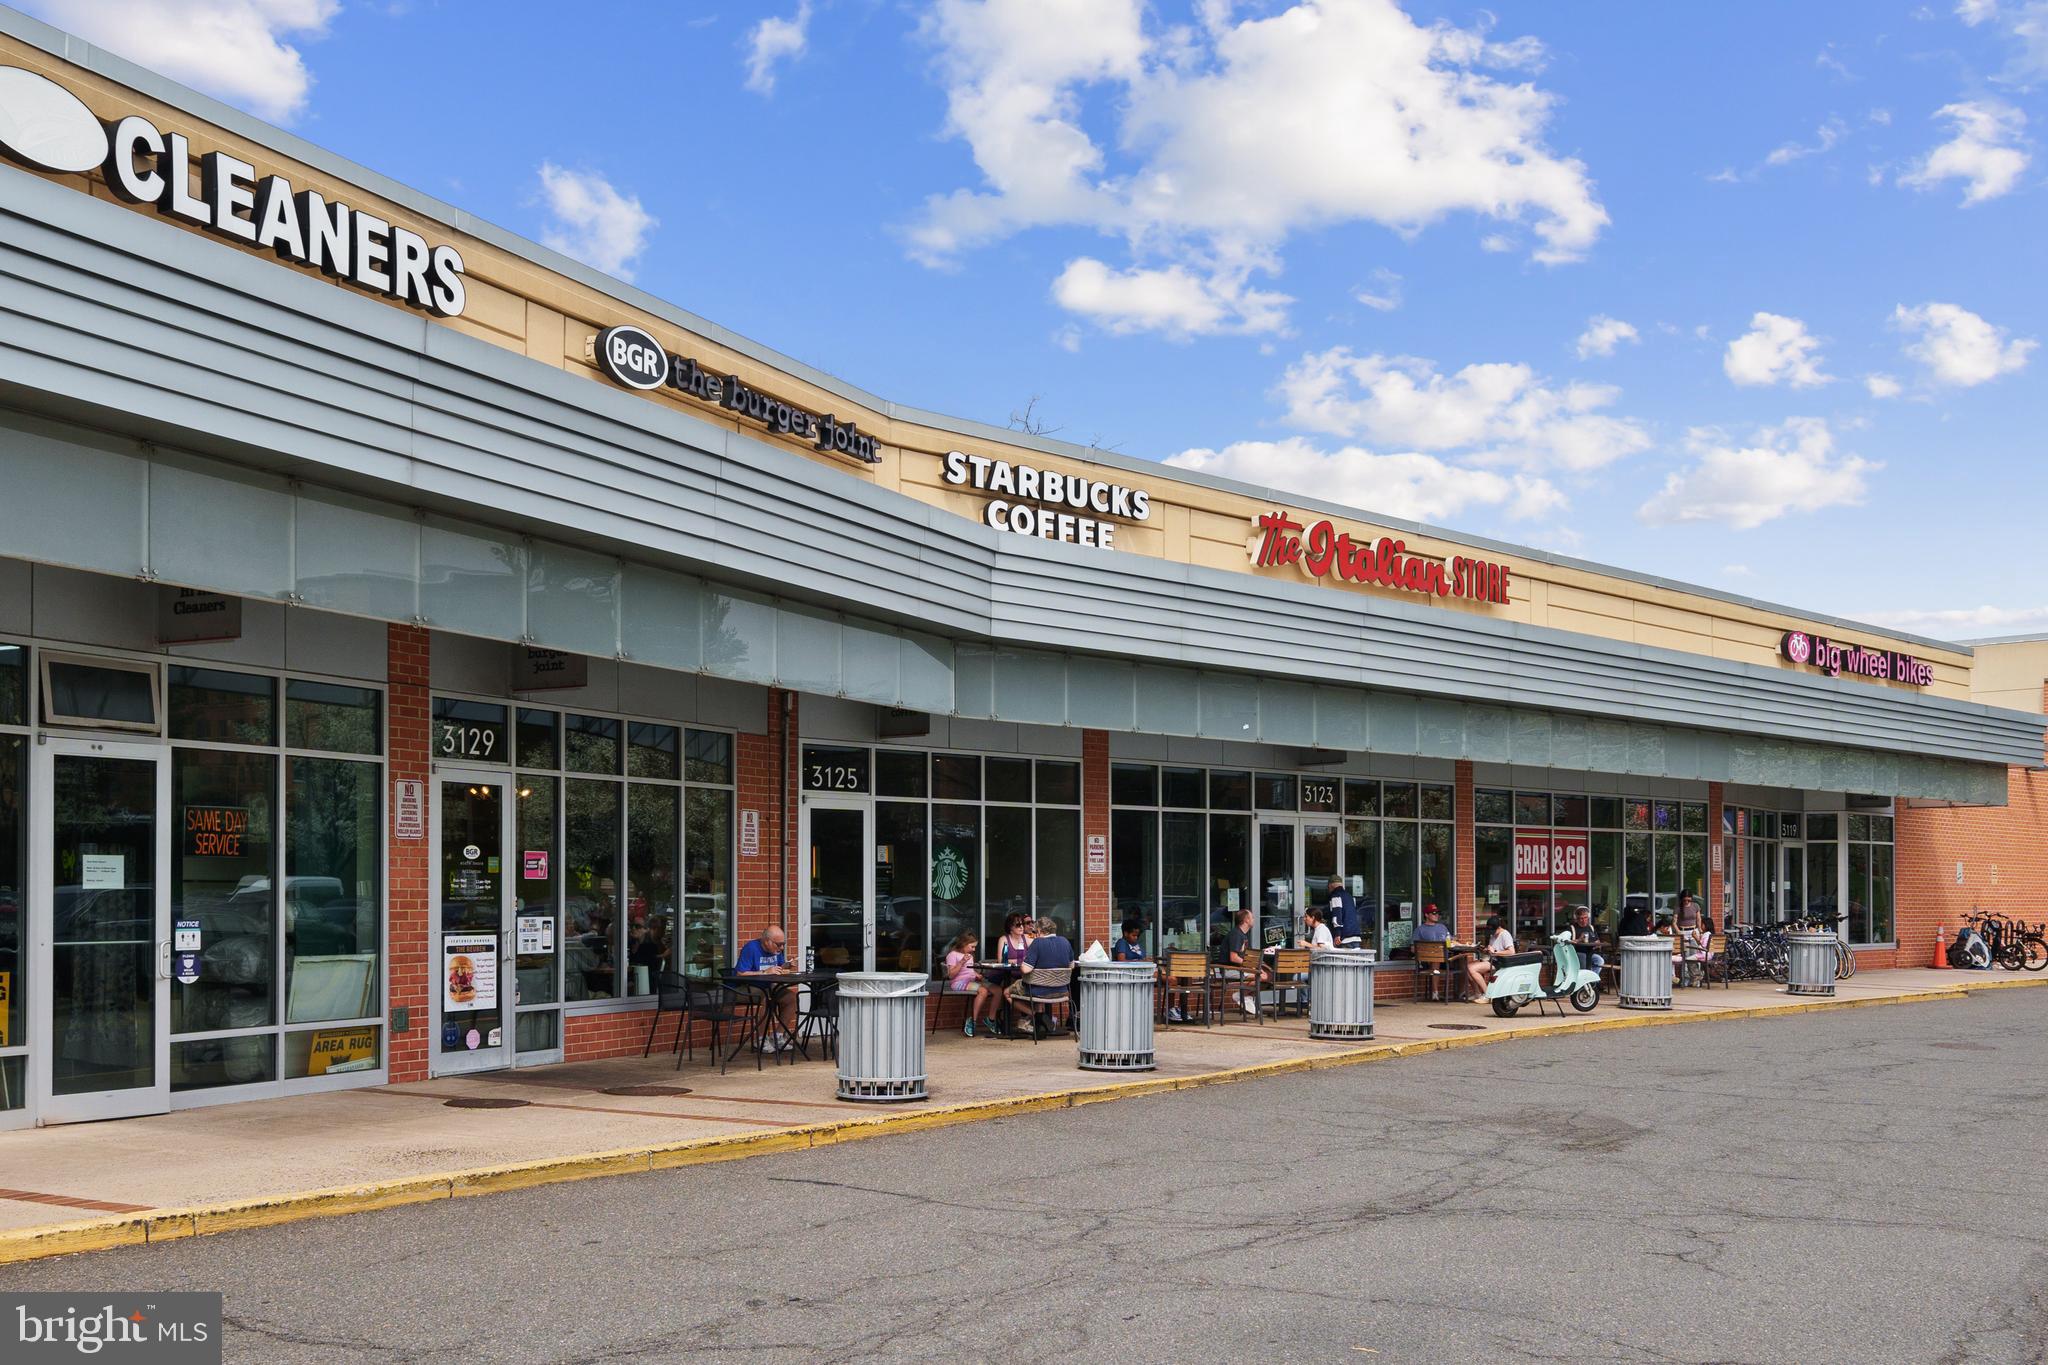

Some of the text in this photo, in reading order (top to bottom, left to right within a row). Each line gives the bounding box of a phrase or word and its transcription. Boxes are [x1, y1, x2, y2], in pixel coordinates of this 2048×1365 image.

[113, 115, 467, 318] CLEANERS
[612, 336, 660, 378] BGR
[673, 353, 882, 464] the burger joint
[944, 450, 1151, 521] STARBUCKS
[986, 499, 1115, 550] COFFEE
[1256, 511, 1511, 604] The Italian STORE
[174, 600, 226, 615] Cleaners
[533, 660, 565, 674] joint
[1815, 638, 1935, 686] big wheel bikes
[442, 725, 495, 756] 3129
[812, 765, 858, 789] 3125
[404, 784, 415, 796] NO
[1304, 785, 1334, 804] 3123
[187, 809, 248, 831] SAME DAY
[1782, 824, 1797, 836] 3119
[195, 834, 240, 857] SERVICE
[465, 848, 478, 856] BGR
[1515, 844, 1548, 875] GRAB
[176, 920, 200, 928] NOTICE
[313, 1037, 372, 1053] AREA RUG
